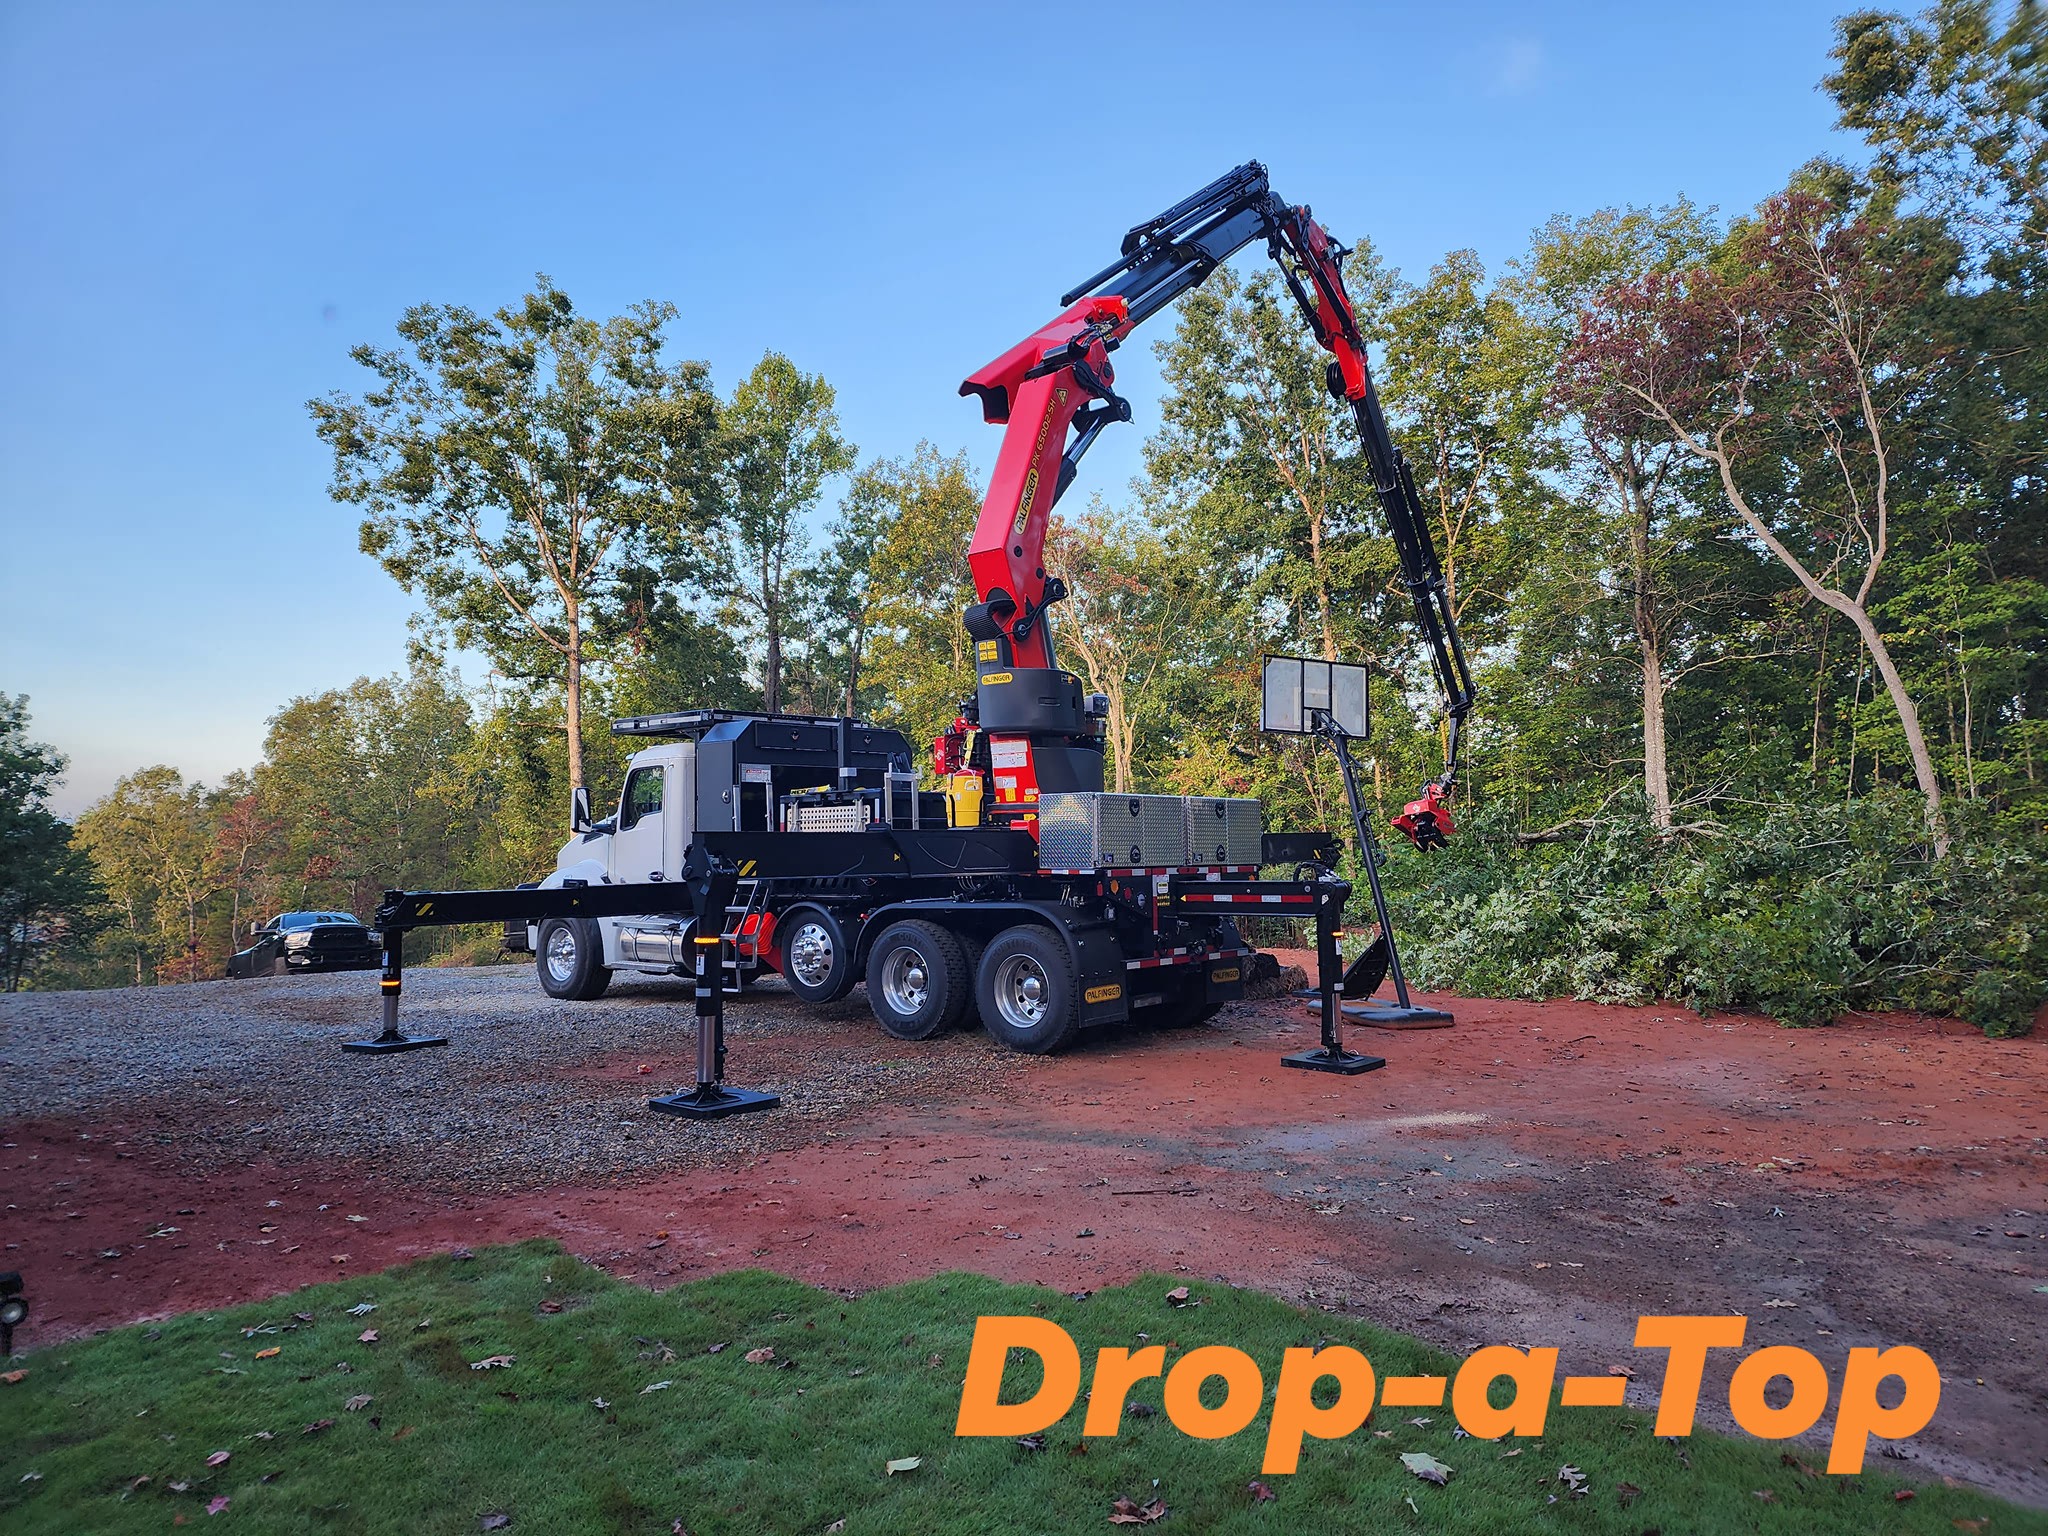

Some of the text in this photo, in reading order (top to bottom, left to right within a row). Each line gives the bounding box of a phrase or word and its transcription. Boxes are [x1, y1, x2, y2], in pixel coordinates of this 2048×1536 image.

[1031, 451, 1041, 467] PK
[1016, 472, 1038, 531] PALFINGER
[1213, 969, 1239, 980] PALFINGER
[1086, 986, 1121, 1000] PALFINGER
